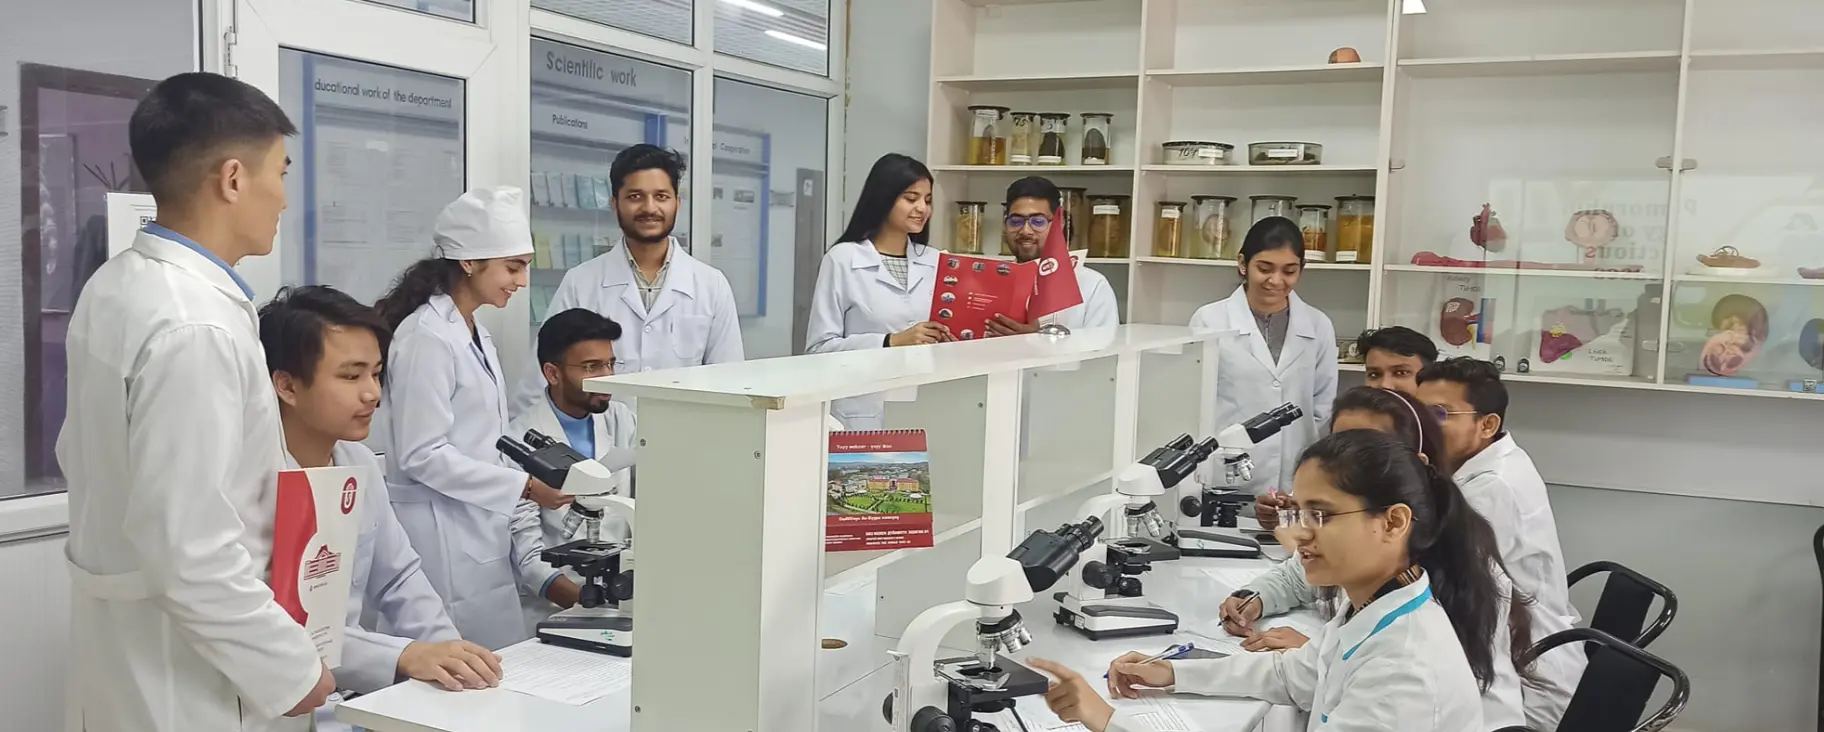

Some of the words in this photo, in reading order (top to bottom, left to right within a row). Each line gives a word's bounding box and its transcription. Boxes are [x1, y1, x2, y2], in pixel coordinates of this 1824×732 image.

[546, 51, 604, 80] Scientific
[610, 67, 637, 87] work
[314, 78, 360, 96] ducational
[361, 86, 381, 99] work
[394, 90, 406, 102] the
